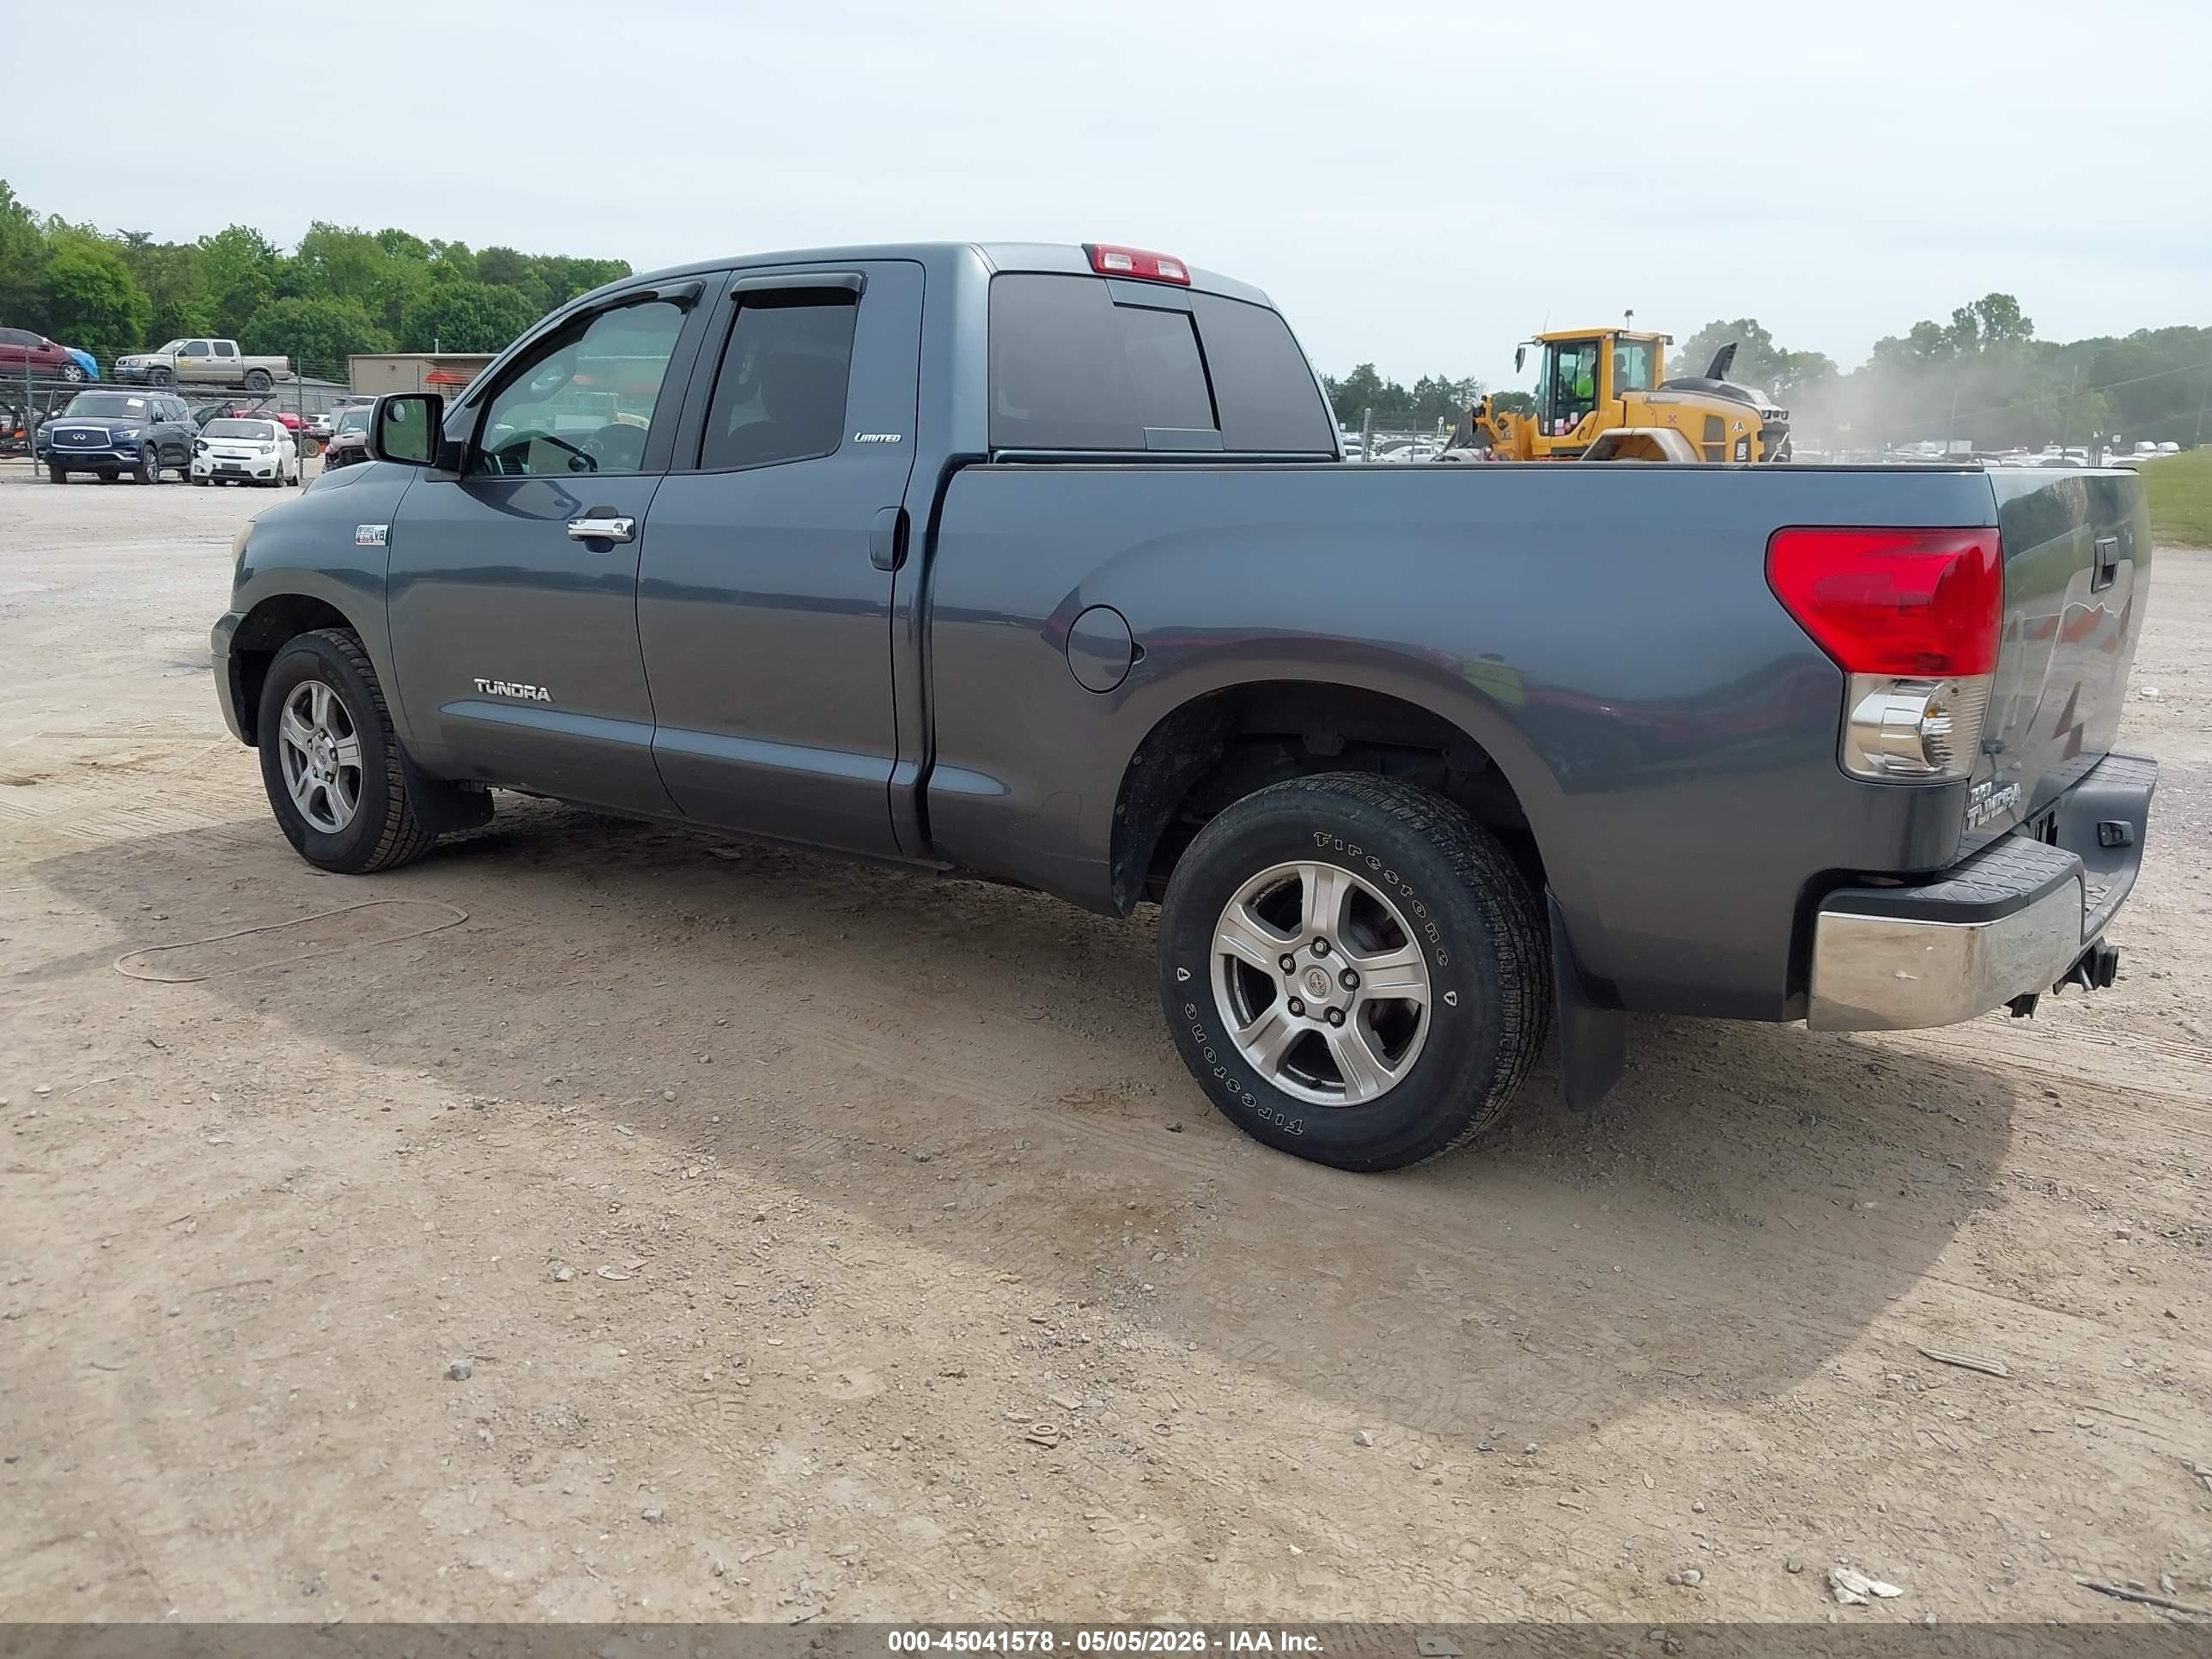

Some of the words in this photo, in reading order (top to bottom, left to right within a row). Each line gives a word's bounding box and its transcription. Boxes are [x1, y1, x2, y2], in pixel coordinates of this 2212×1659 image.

[854, 432, 902, 443] LIMITED
[374, 529, 386, 541] V8
[473, 678, 554, 702] TUNDRA
[1966, 781, 2021, 832] TUNDRA
[1313, 830, 1449, 967] Firestone
[1184, 1002, 1304, 1136] Firestone
